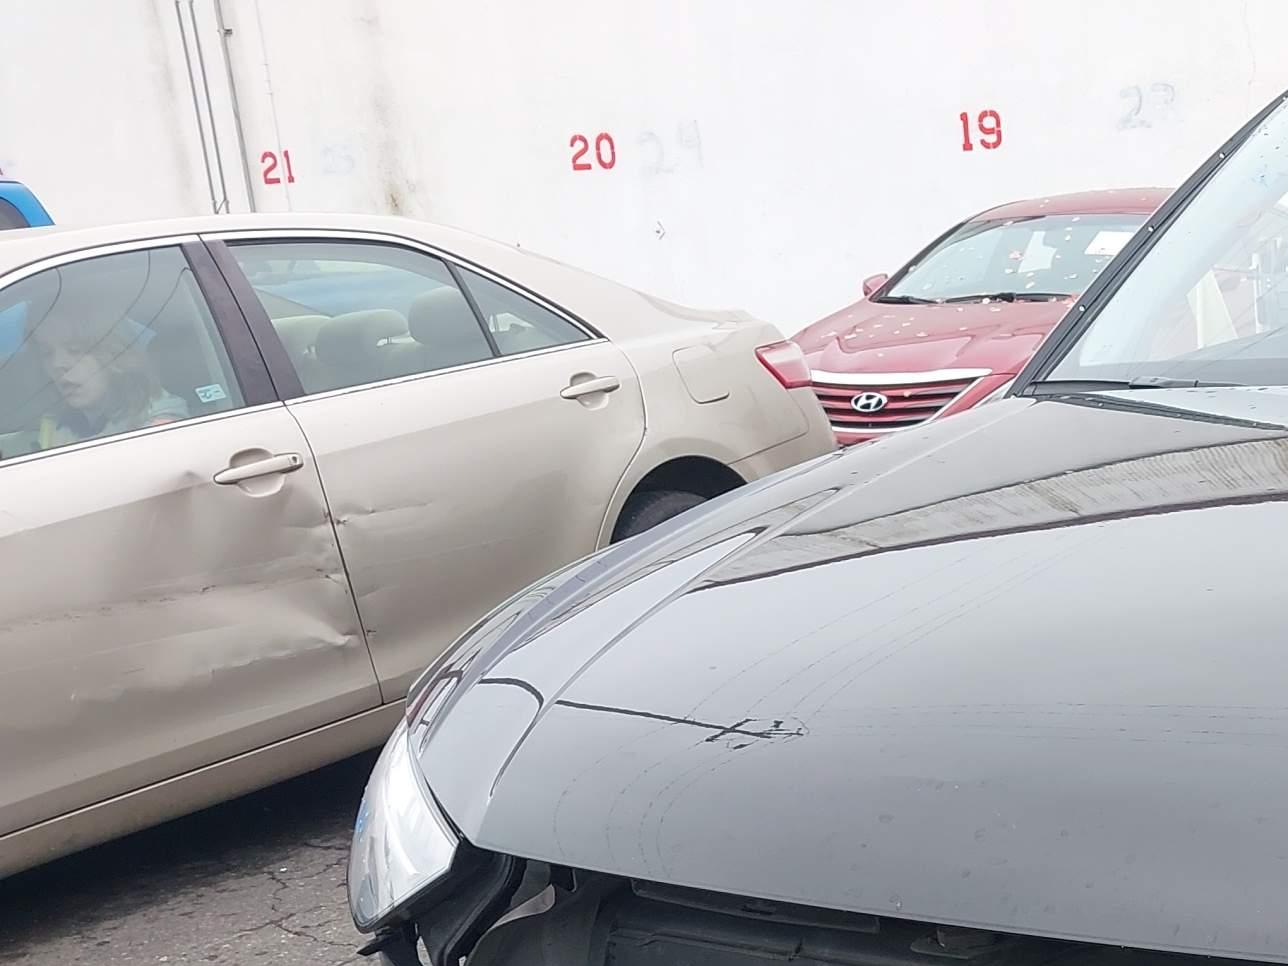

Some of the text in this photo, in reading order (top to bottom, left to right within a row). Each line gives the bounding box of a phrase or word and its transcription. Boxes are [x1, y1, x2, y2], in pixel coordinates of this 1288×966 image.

[959, 109, 1003, 152] 19
[260, 150, 295, 185] 21
[570, 132, 616, 171] 20
